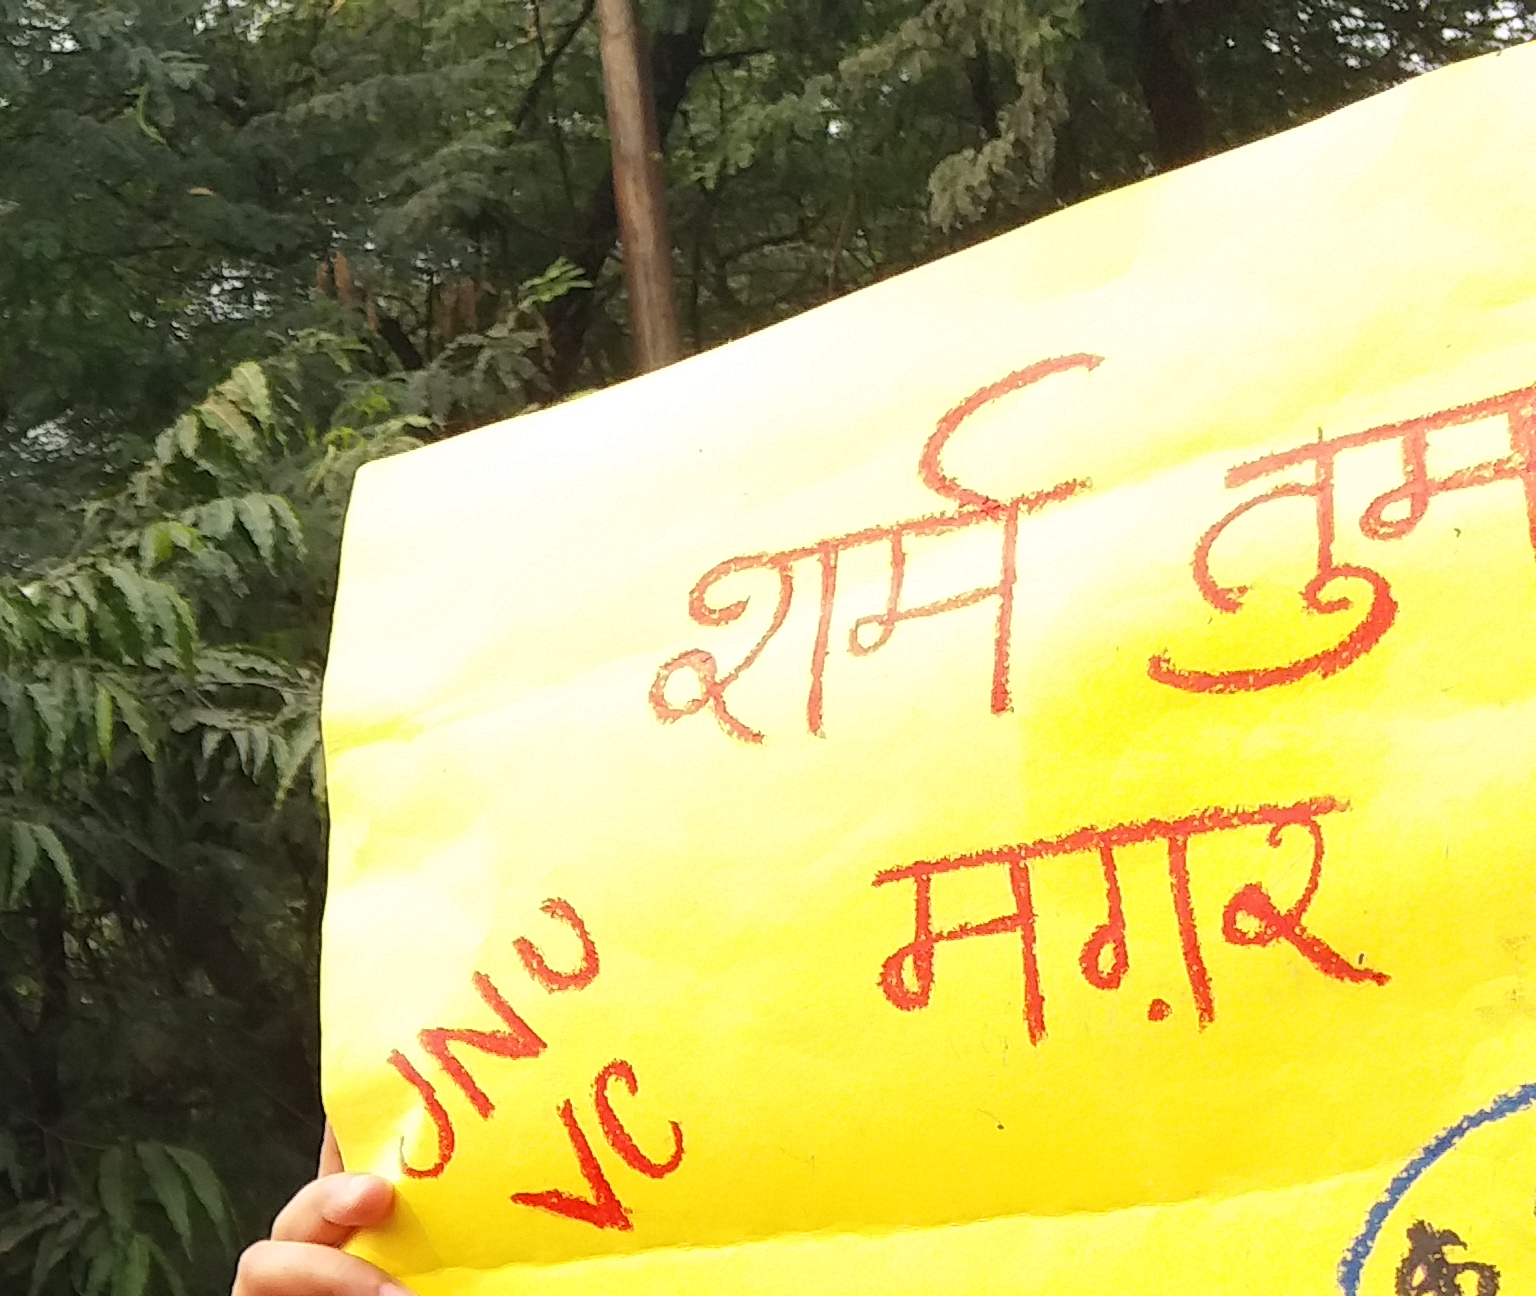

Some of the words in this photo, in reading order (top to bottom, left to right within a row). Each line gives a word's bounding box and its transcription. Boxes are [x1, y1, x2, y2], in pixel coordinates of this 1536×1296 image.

[649, 352, 1106, 743] शर्म
[387, 897, 599, 1181] JNU
[510, 1058, 685, 1232] VC
